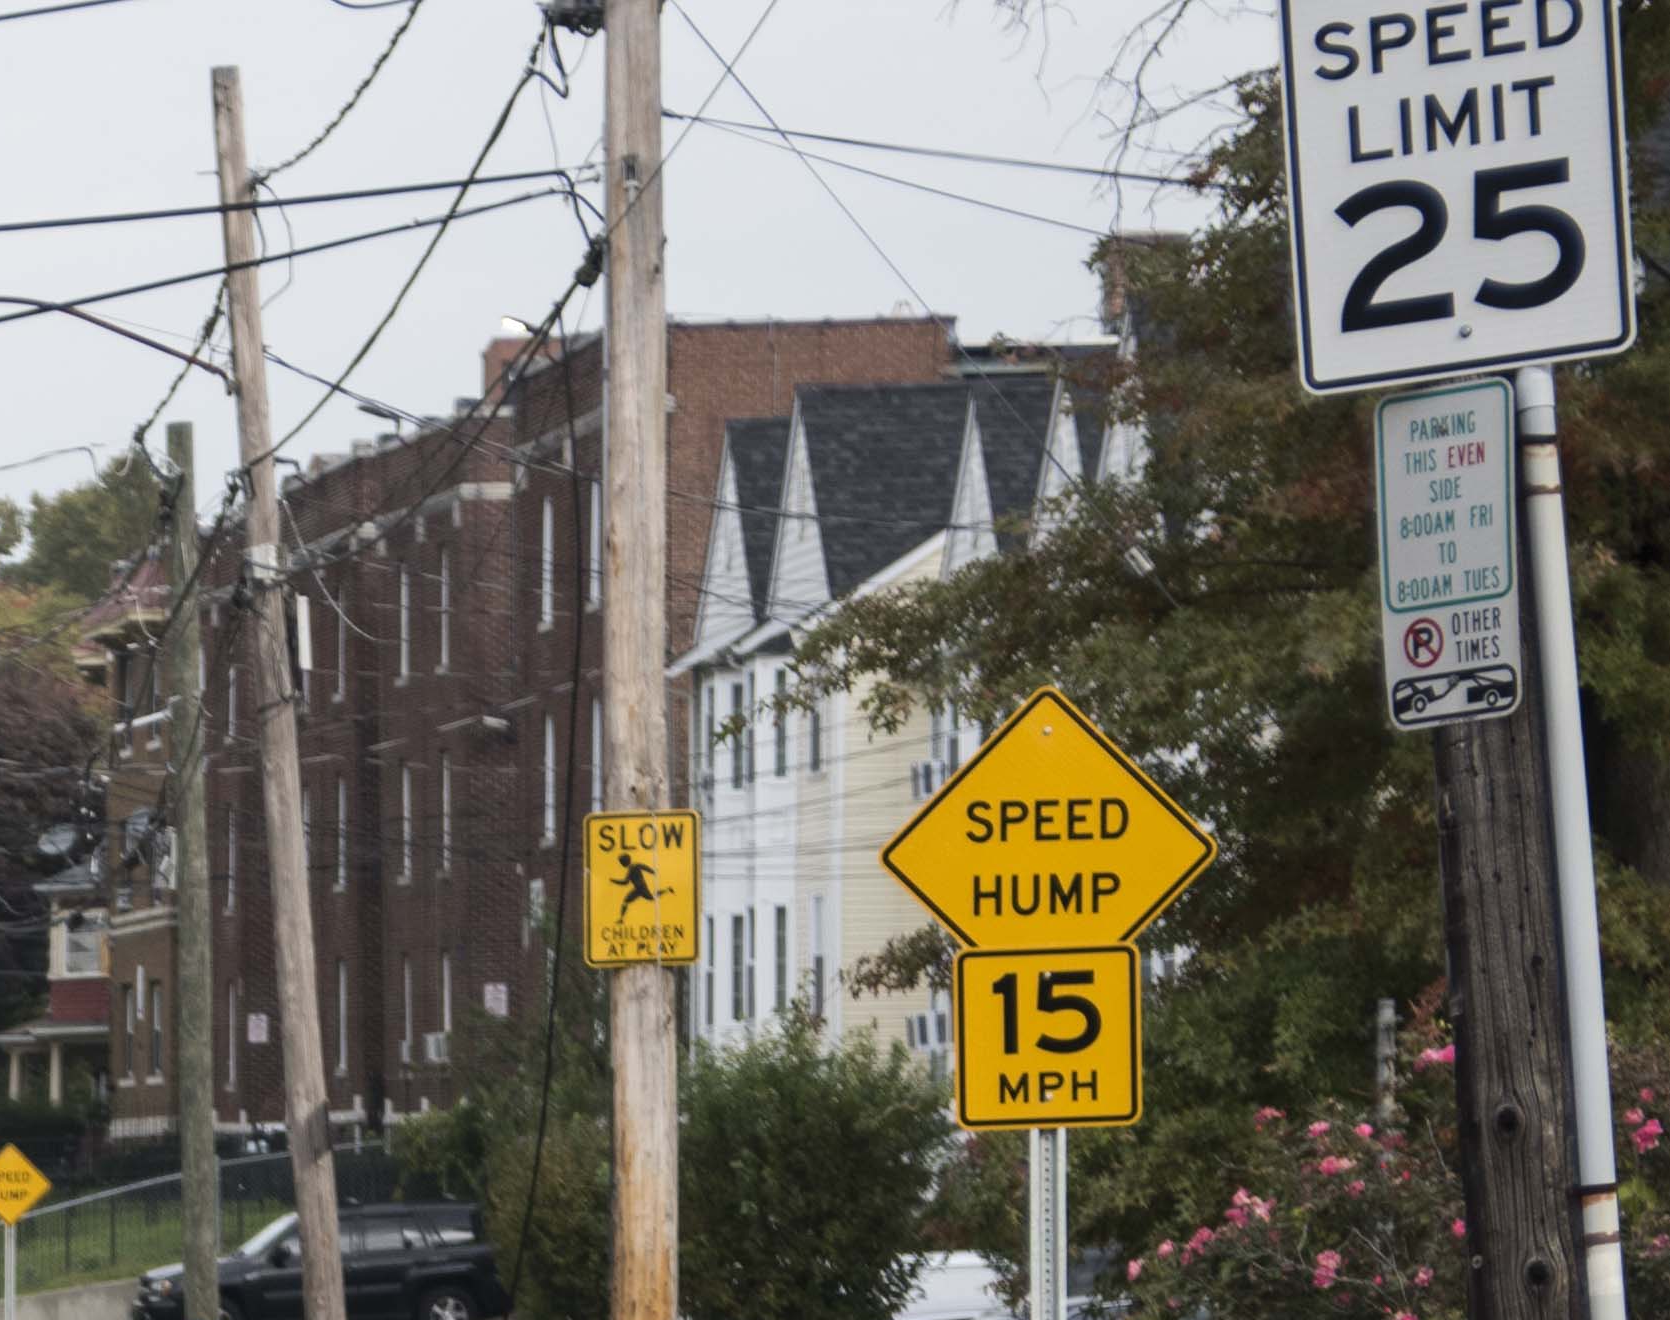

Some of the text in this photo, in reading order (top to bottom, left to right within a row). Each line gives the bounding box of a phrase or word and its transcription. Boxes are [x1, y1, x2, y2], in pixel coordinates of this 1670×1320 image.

[1314, 0, 1583, 81] SPEED
[1348, 75, 1555, 163] LIMIT
[1334, 157, 1586, 333] 25
[1410, 411, 1476, 443] PARKING
[1405, 442, 1486, 475] THIS EVEN
[1429, 477, 1462, 503] SIDE
[1400, 504, 1493, 539] 8:00AM FRI
[1438, 541, 1457, 565] TO
[1398, 566, 1501, 603] 8:00AM TUES
[1452, 607, 1501, 635] OTHER
[1456, 635, 1501, 664] TIMES
[599, 822, 684, 851] SLOW
[965, 797, 1129, 843] SPEED
[972, 872, 1121, 917] HUMP
[601, 924, 684, 941] CHILDREN
[608, 942, 677, 956] AT PLAY
[992, 970, 1101, 1055] 15
[999, 1070, 1098, 1104] MPH
